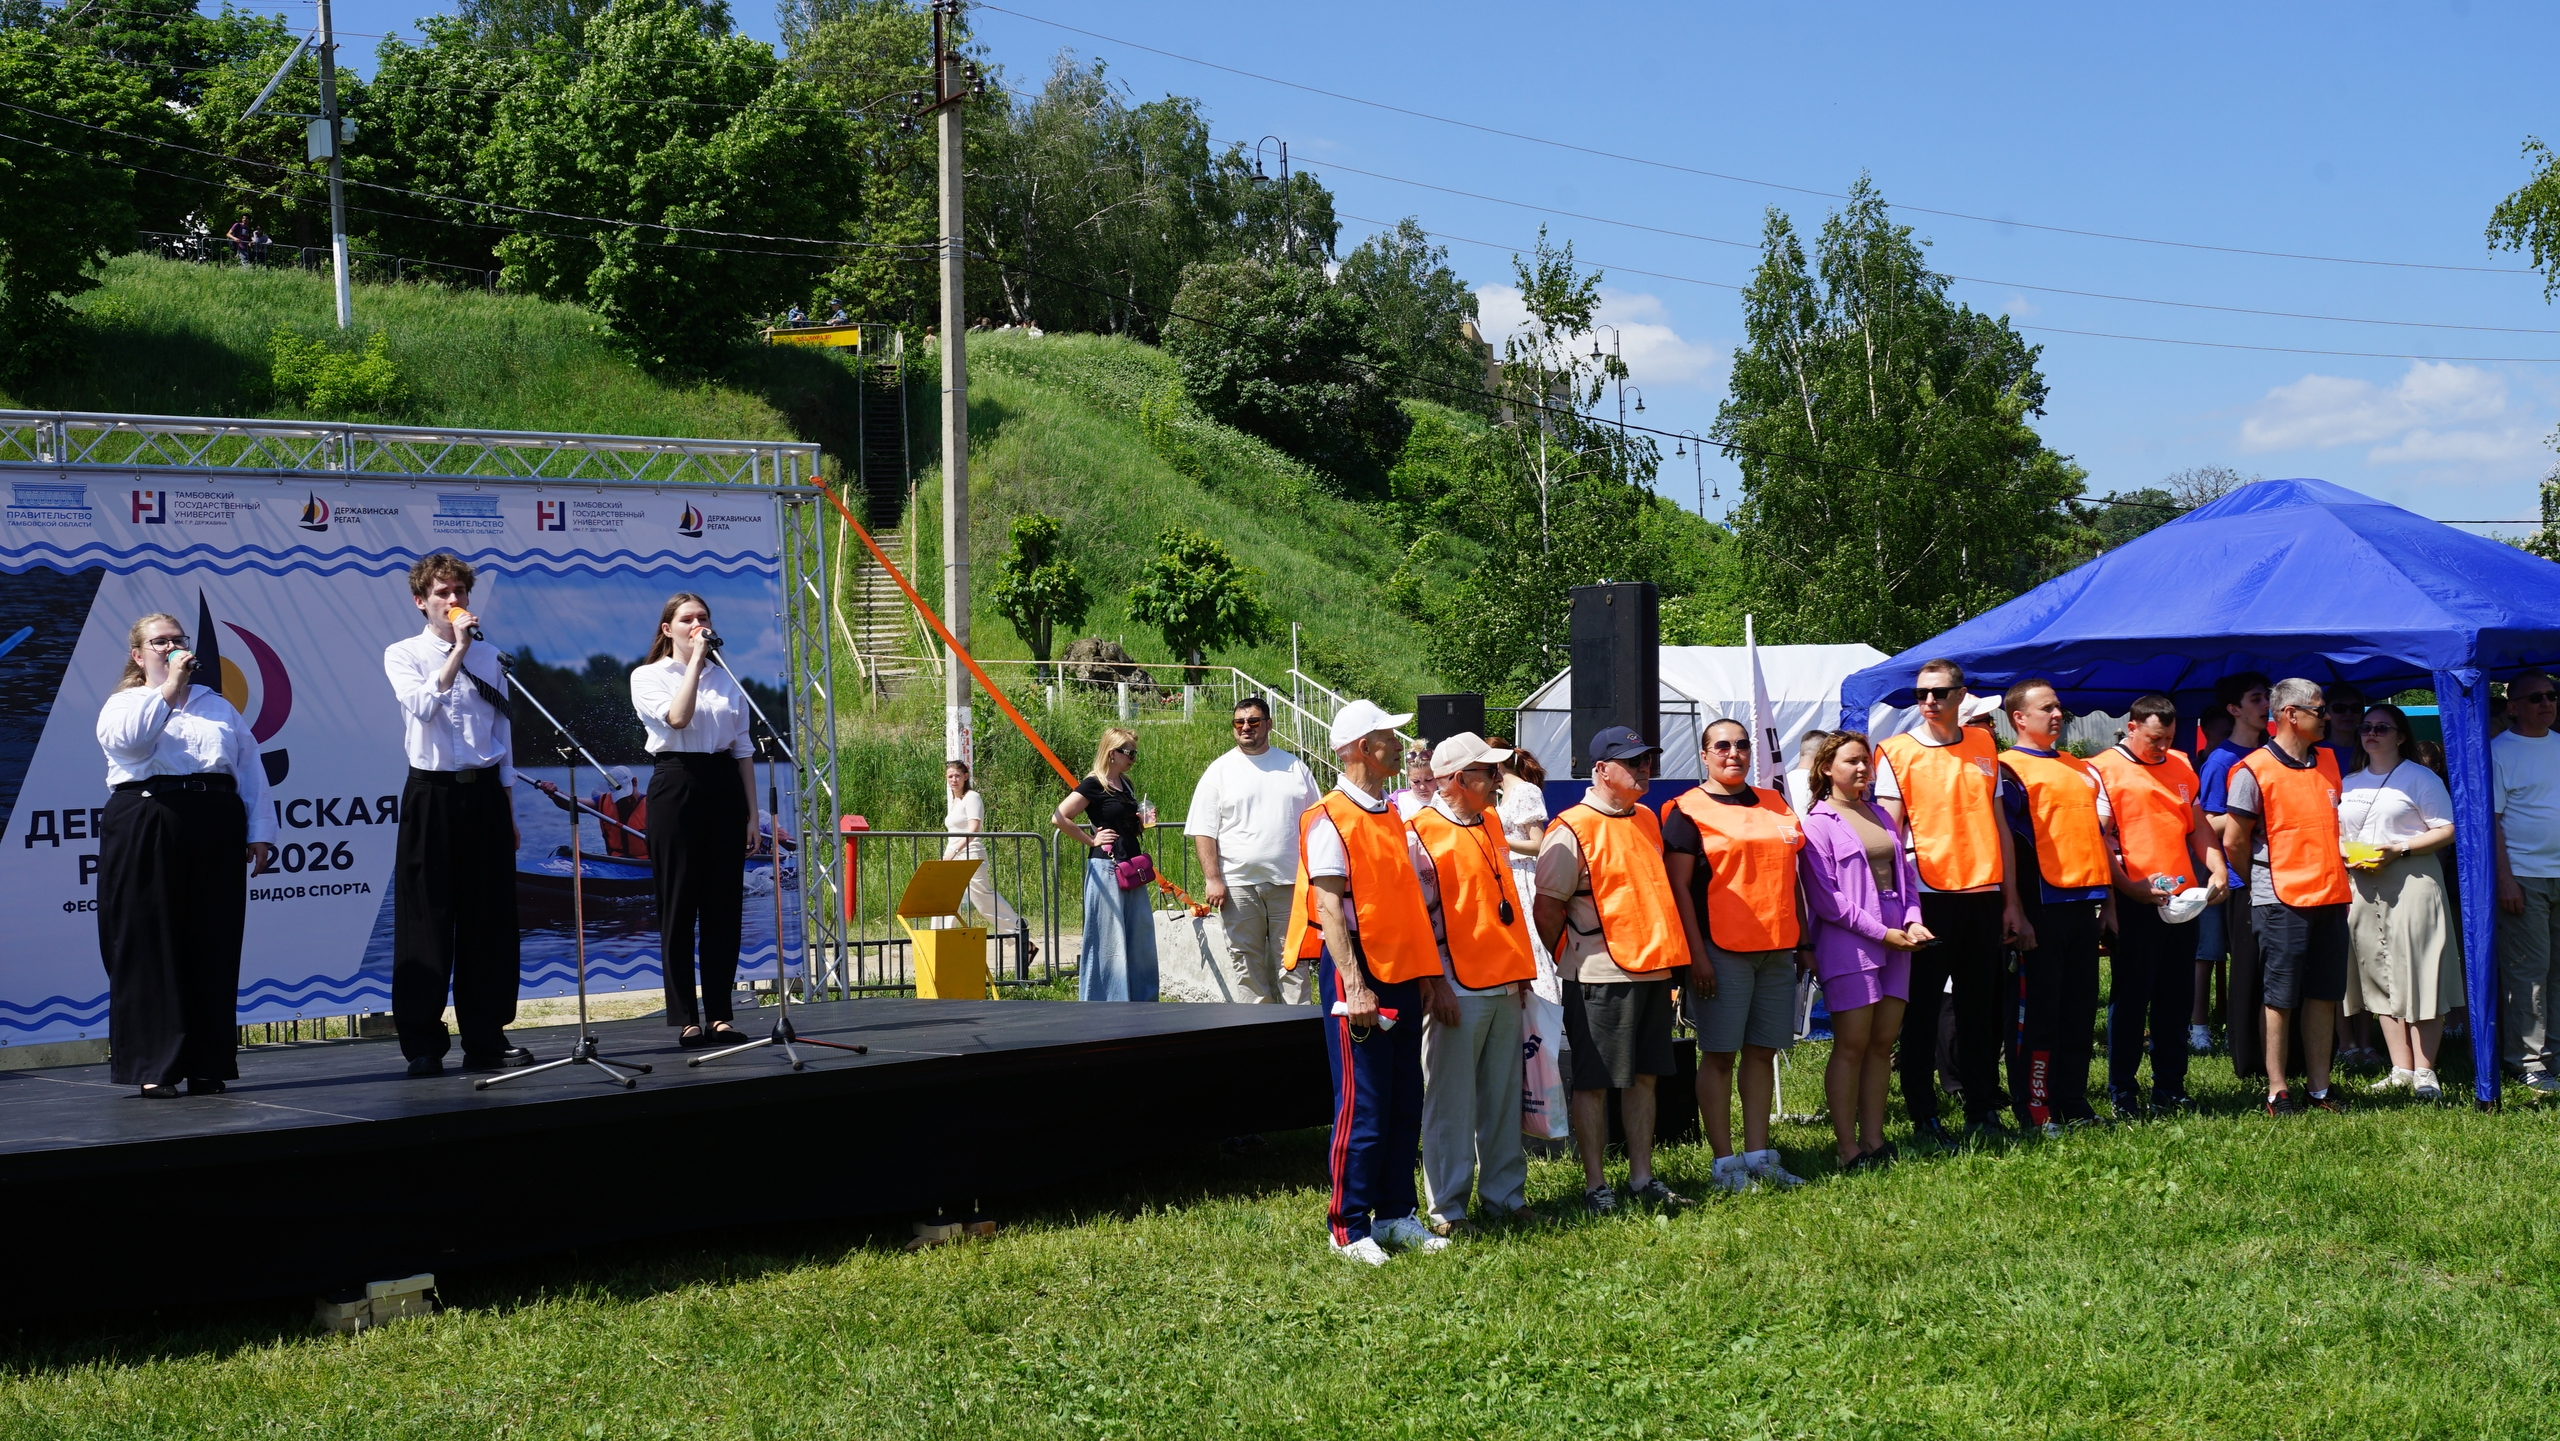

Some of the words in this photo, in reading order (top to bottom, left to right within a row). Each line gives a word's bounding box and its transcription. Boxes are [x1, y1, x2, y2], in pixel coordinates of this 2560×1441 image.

[174, 491, 234, 499] ТАМБОВСКИЙ
[174, 501, 261, 510] ГОСУДАРСТВЕННЫЙ
[334, 507, 399, 515] ДЕРЖАВИНСКАЯ
[572, 510, 645, 518] ГОСУДАРСТВЕННЫЙ
[6, 511, 92, 520] ПРАВИТЕЛЬСТВО
[432, 519, 504, 527] ПРАВИТЕЛЬСТВО
[259, 840, 354, 874] 2026
[250, 886, 306, 902] ВИДОВ
[308, 882, 371, 897] СПОРТА
